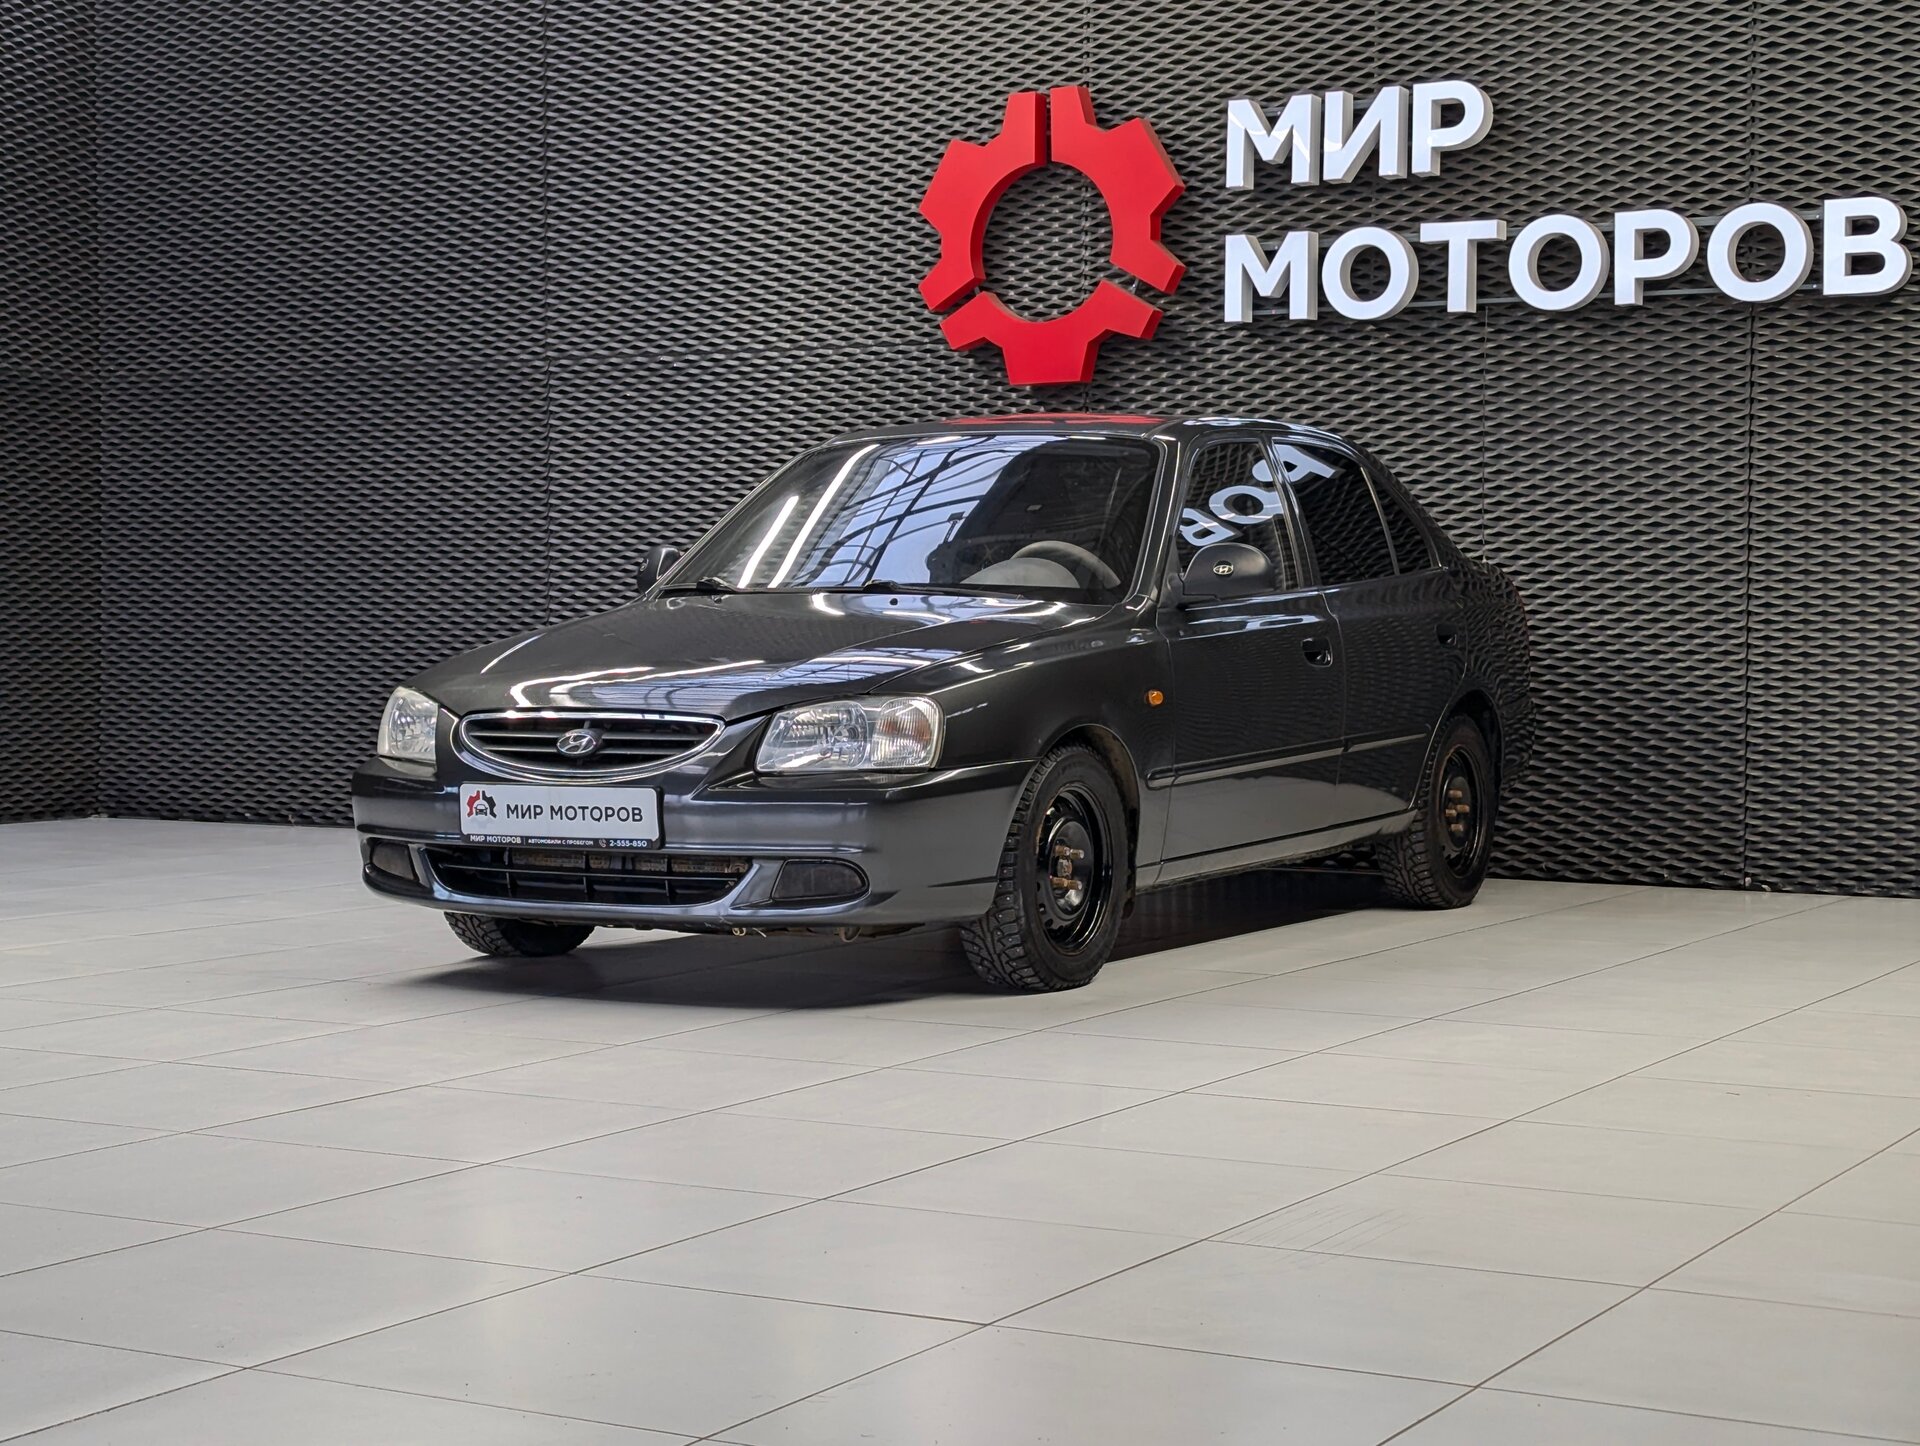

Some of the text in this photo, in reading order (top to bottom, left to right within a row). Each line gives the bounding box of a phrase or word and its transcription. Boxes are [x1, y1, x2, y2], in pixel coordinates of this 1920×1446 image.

[1226, 80, 1493, 190] МИР
[1222, 195, 1912, 324] МОТОРОВ
[470, 834, 485, 842] МИР
[487, 835, 522, 843] МОТОРОВ
[609, 839, 648, 847] 2-555-850
[506, 803, 643, 822] МИР МОТОРОВ
